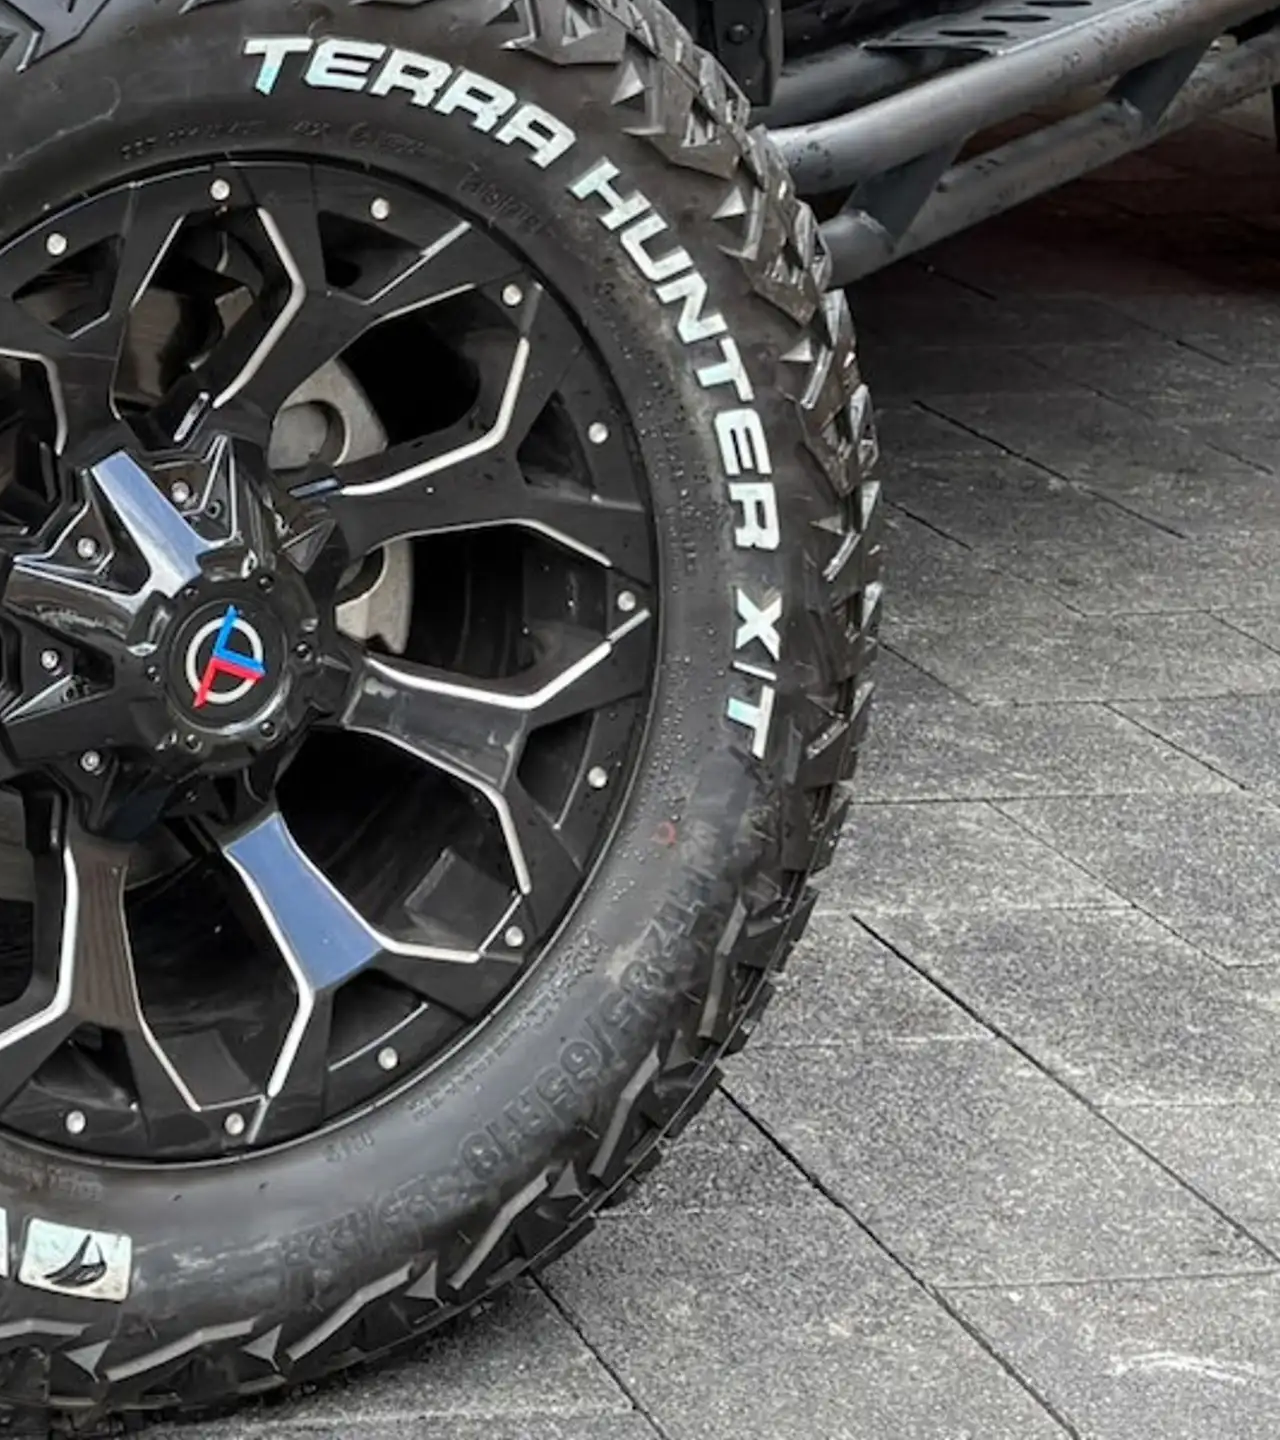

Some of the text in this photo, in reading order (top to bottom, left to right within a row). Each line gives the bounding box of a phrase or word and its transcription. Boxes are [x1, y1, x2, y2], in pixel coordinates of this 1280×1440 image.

[243, 37, 578, 171] TERRA
[567, 157, 782, 550] HUNTER
[728, 587, 783, 759] X/T
